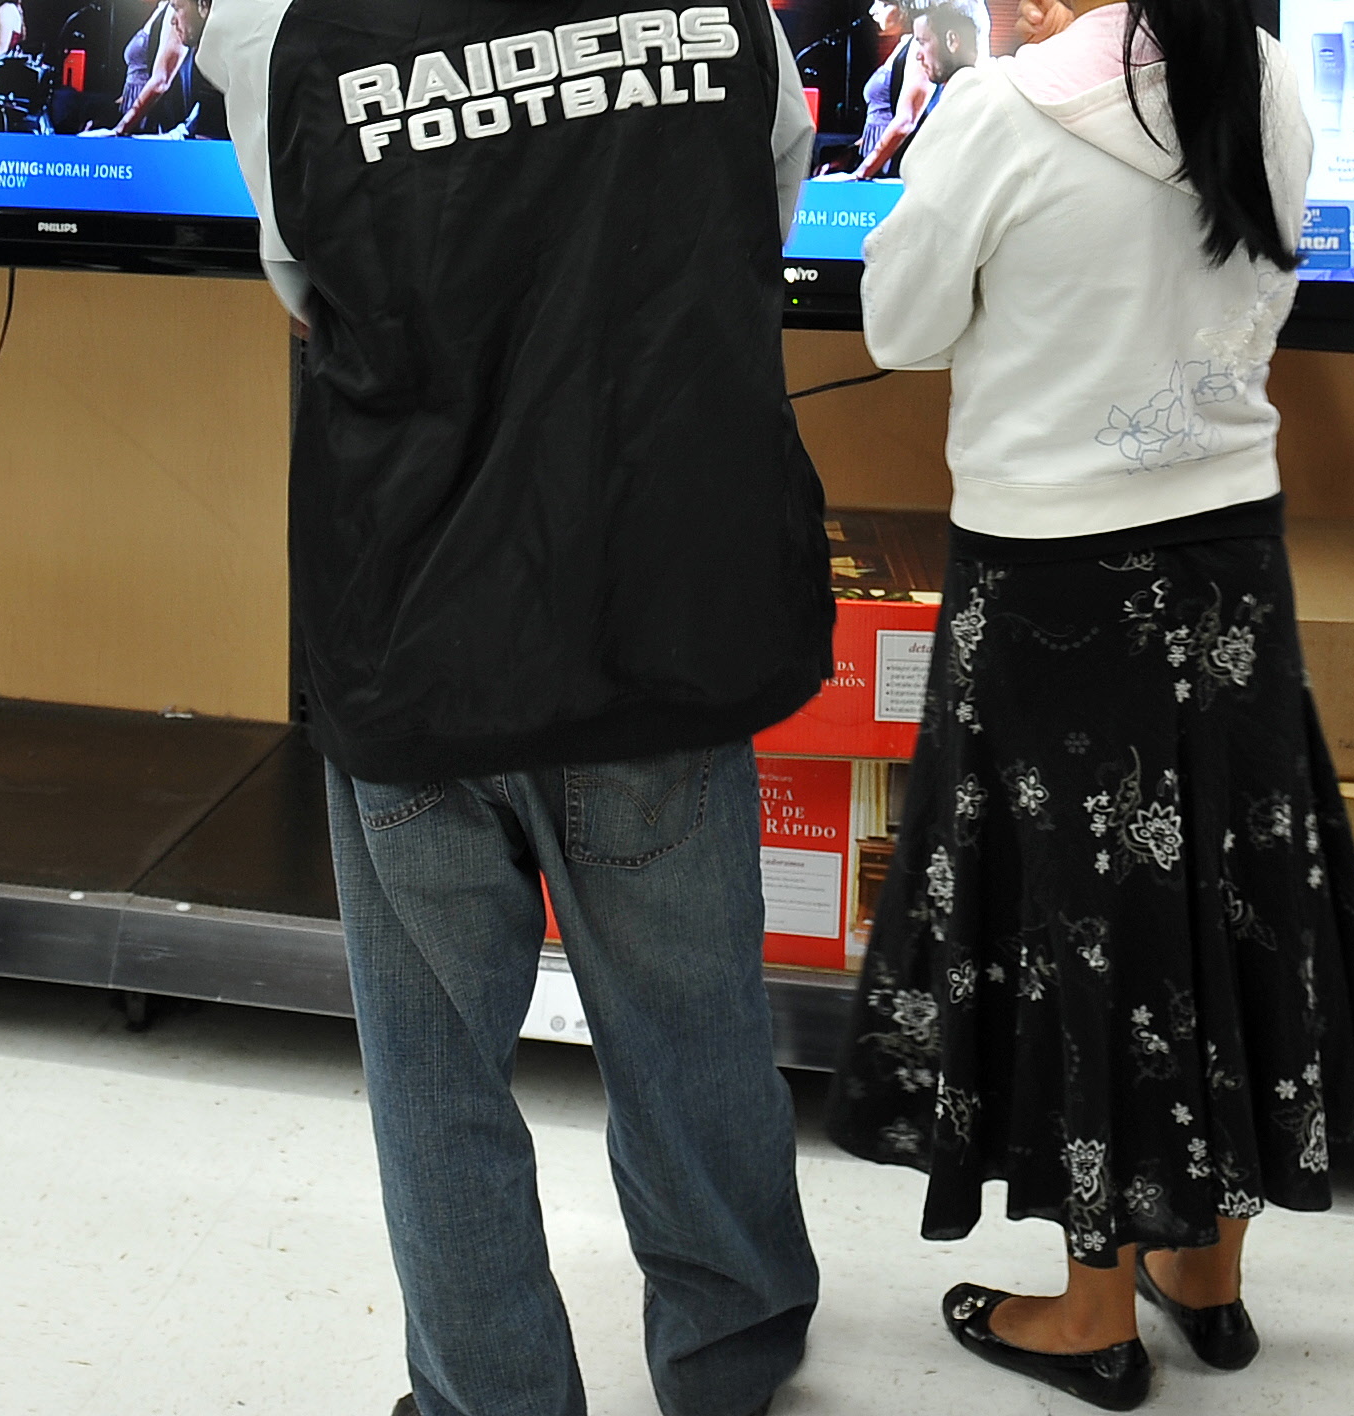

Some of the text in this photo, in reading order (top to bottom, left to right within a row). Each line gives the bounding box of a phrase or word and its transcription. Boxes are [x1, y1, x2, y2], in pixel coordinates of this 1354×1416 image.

[338, 7, 740, 125] RAIDERS
[359, 62, 726, 163] FOOTBALL
[46, 163, 90, 178] NORAH
[93, 165, 133, 180] JONES
[831, 211, 876, 227] JONES
[1302, 208, 1322, 227] 2"
[38, 222, 78, 234] PHILIPS
[783, 267, 819, 283] NYO
[782, 805, 805, 820] DE
[766, 817, 837, 840] RÁPIDO
